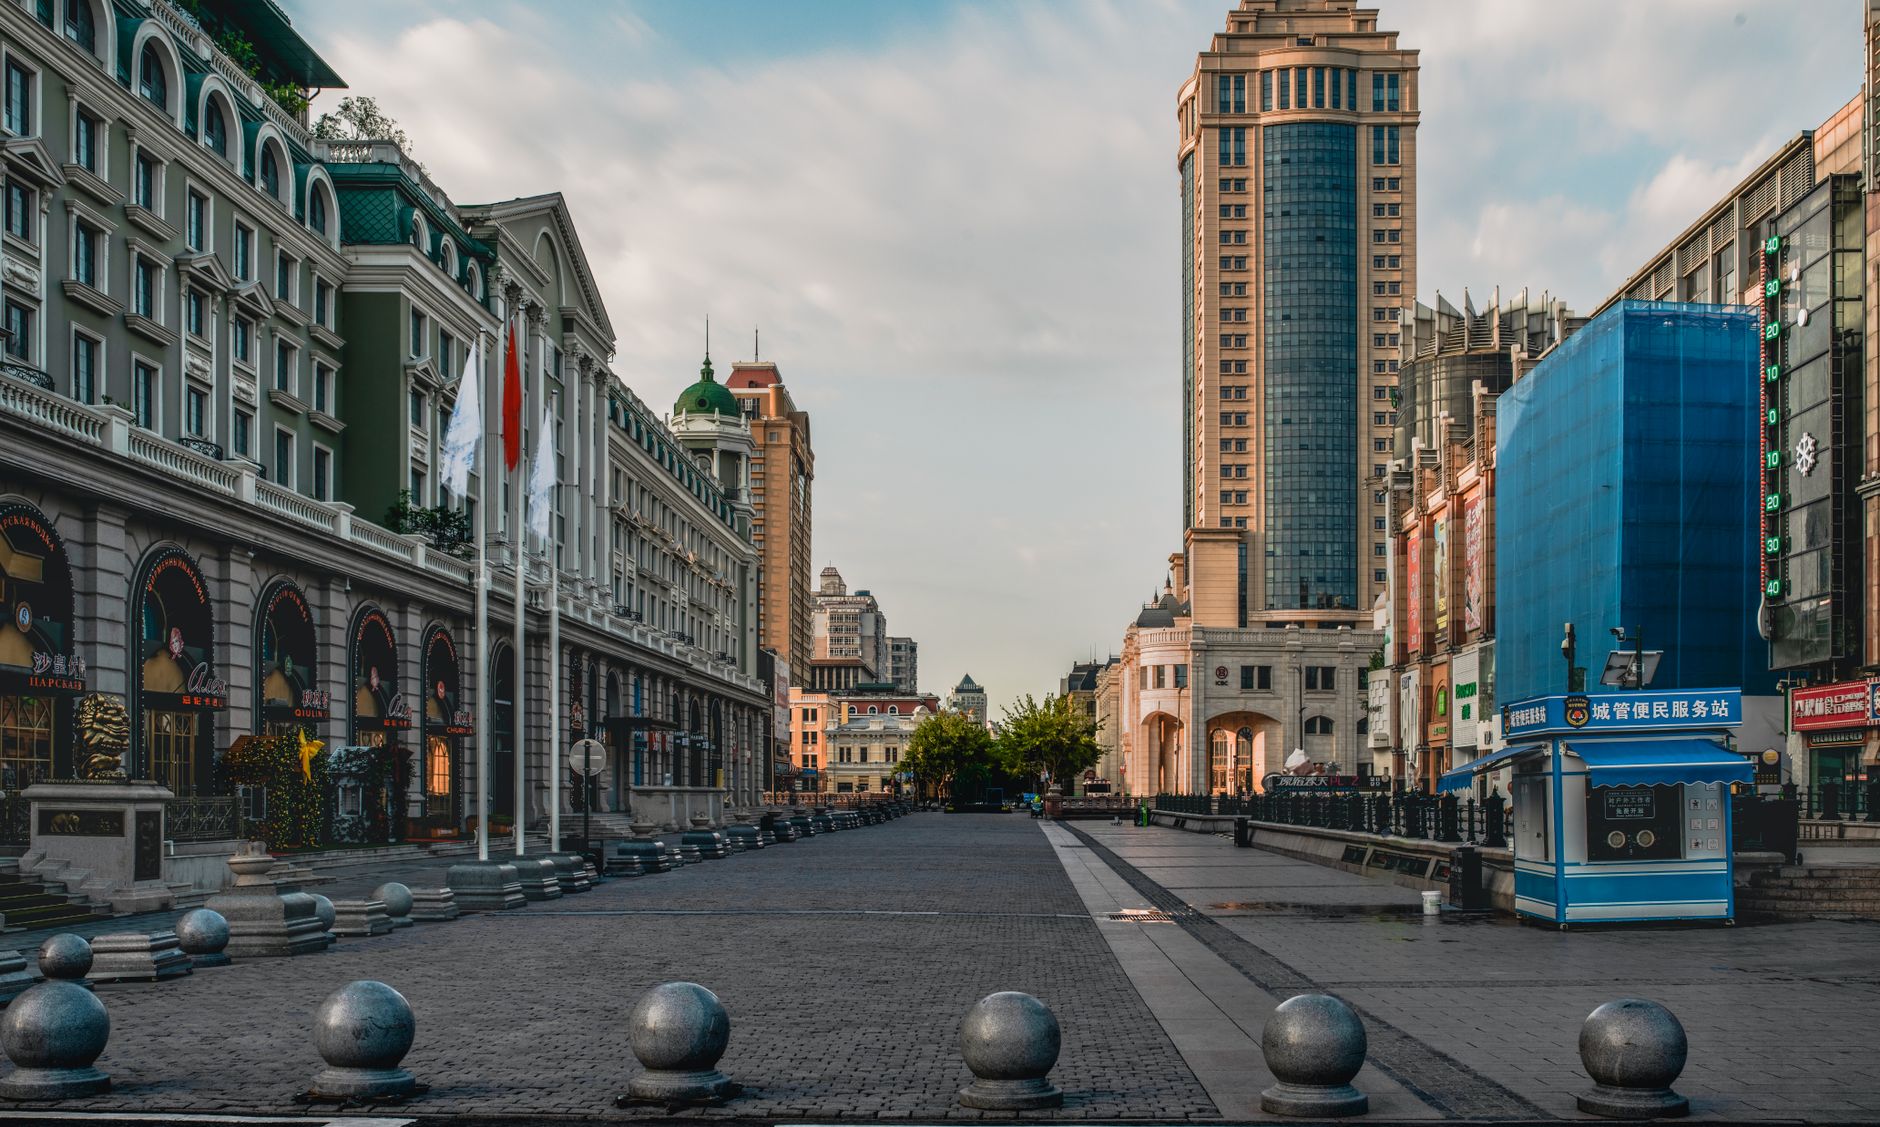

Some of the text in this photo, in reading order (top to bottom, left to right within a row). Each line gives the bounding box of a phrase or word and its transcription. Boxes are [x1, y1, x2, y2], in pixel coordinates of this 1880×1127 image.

[1766, 236, 1779, 253] 40
[1766, 280, 1779, 296] 30
[1766, 323, 1779, 340] 20
[1766, 367, 1778, 382] 10
[1769, 410, 1776, 424] 0
[1767, 452, 1778, 466] 10
[1767, 495, 1778, 509] 20
[1767, 538, 1778, 552] 30
[1767, 581, 1778, 595] 40
[1510, 705, 1546, 728] 城管便民服务站
[1591, 699, 1730, 721] 城管便民服务站
